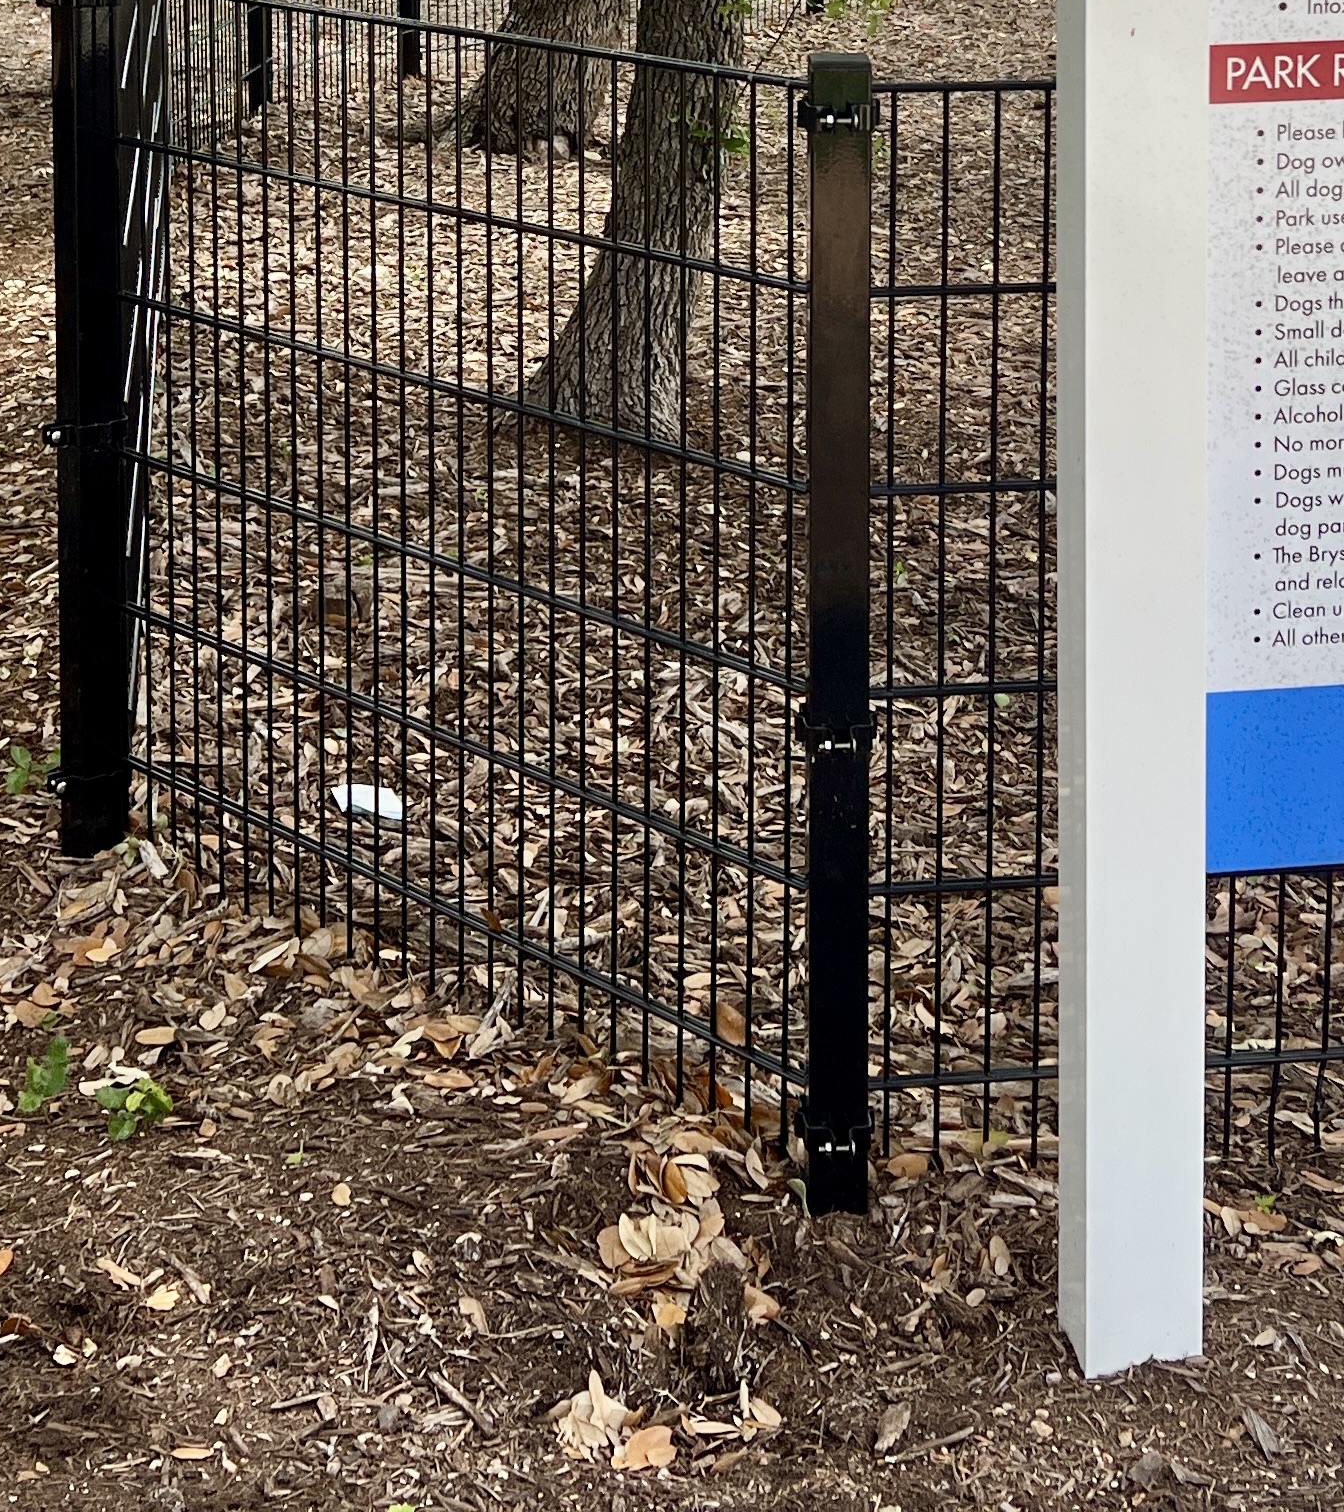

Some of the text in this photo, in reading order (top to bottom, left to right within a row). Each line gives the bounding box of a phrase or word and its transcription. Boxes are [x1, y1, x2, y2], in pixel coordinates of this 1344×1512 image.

[1226, 53, 1321, 91] PARK
[1273, 376, 1325, 397] Glass
[1273, 434, 1303, 453] No
[1273, 462, 1321, 485] Dogs
[1275, 490, 1322, 512] Dogs
[1274, 516, 1311, 540] dog
[1271, 545, 1302, 564] The
[1274, 571, 1309, 592] and
[1271, 627, 1295, 647] All
